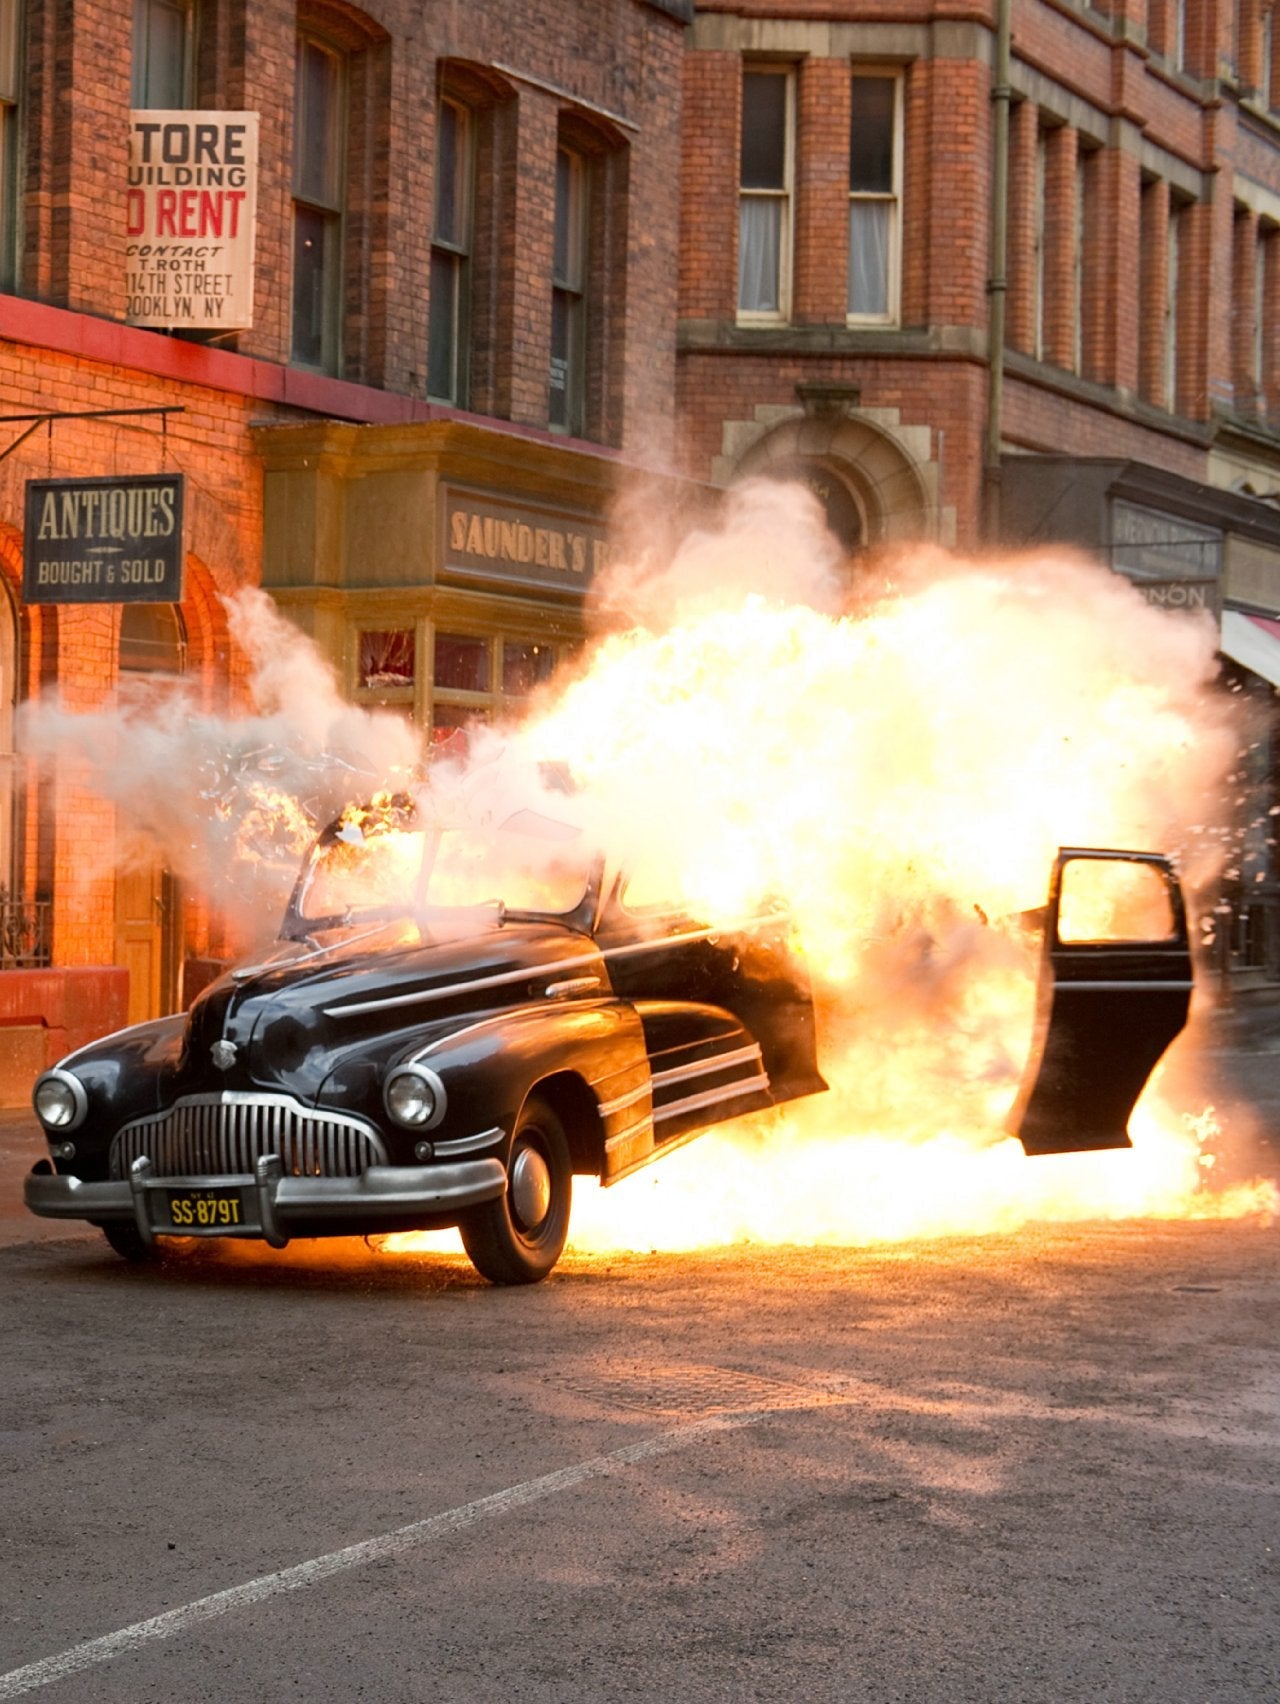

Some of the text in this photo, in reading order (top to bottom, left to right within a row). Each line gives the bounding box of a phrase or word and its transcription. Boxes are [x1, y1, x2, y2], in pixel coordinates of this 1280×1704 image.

[127, 123, 246, 165] TORE
[156, 189, 246, 238] RENT
[126, 244, 223, 258] CONTACT
[139, 259, 205, 271] T.ROTH
[204, 298, 224, 318] NY
[37, 487, 176, 541] ANTIQUES
[450, 511, 587, 573] SAUNDER'S
[38, 559, 165, 585] BOUGHT & SOLD
